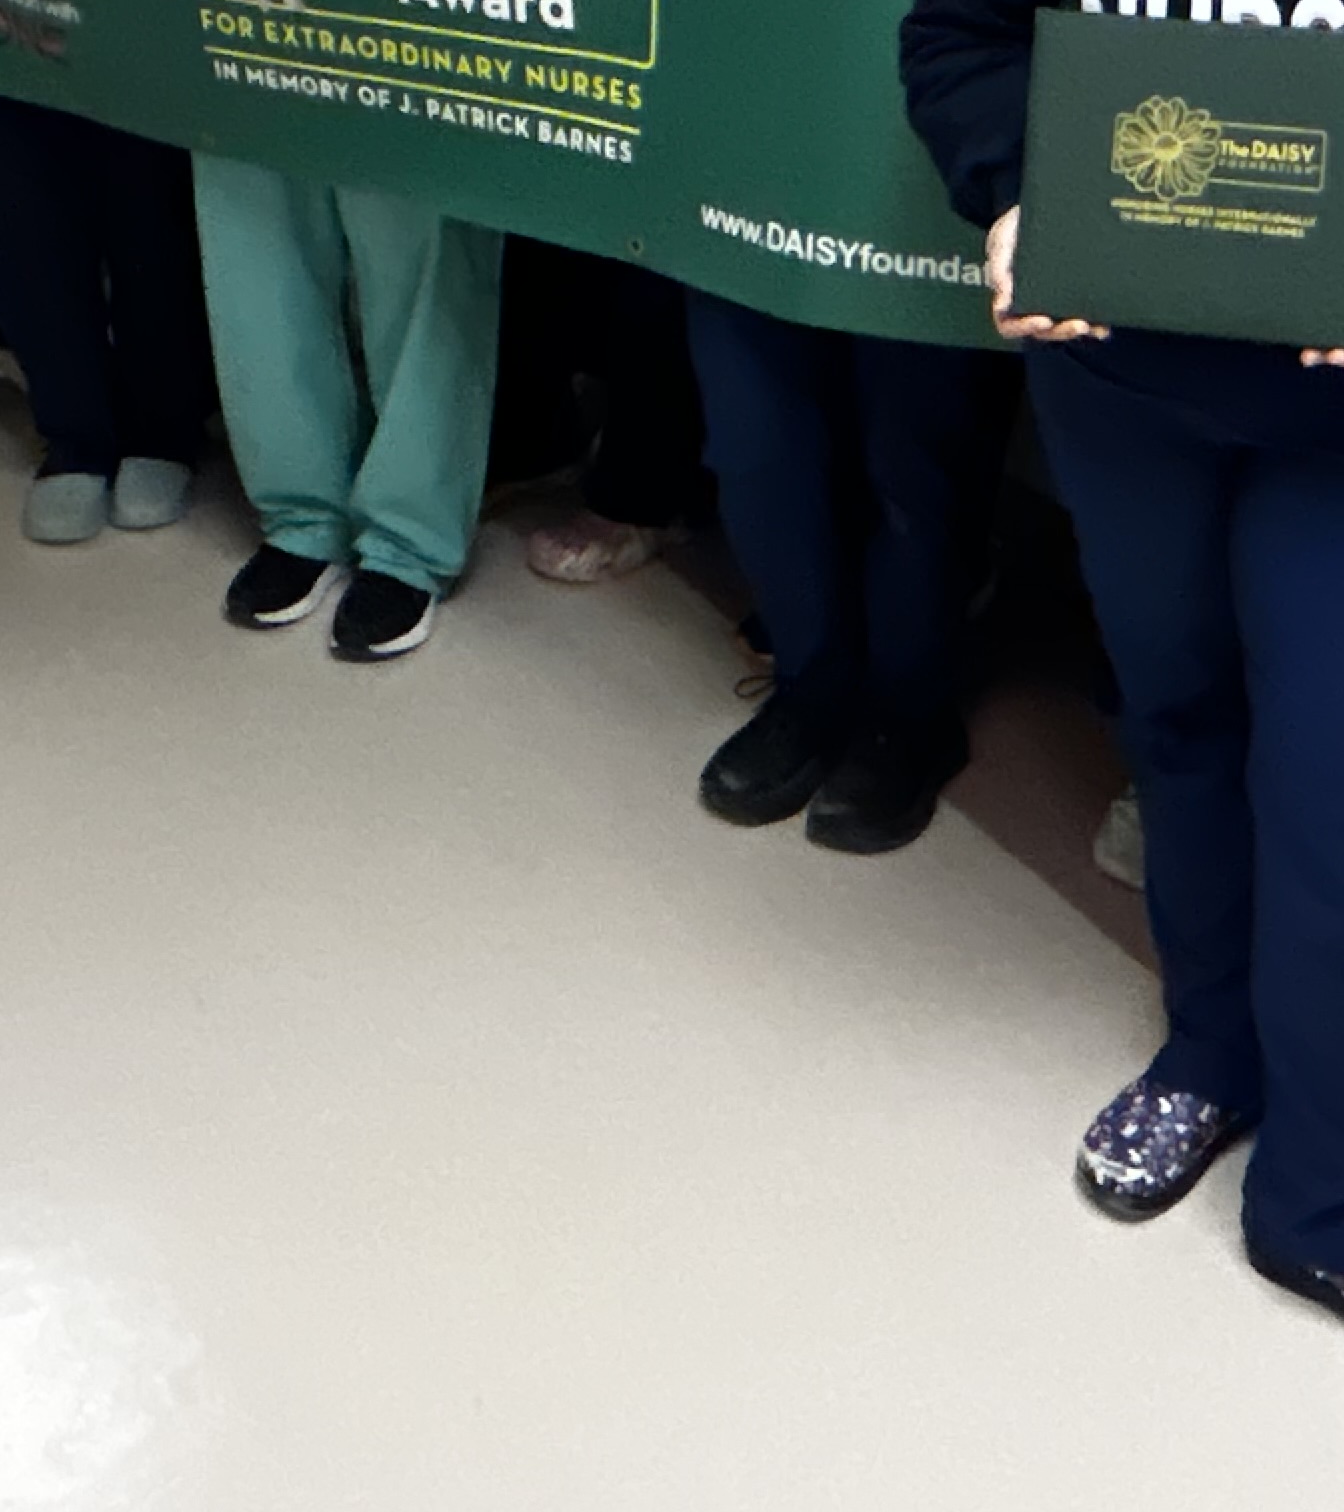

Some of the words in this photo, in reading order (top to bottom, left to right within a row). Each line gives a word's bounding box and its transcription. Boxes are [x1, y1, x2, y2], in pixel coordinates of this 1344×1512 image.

[200, 8, 254, 38] FOR
[262, 19, 512, 83] EXTRAORDINARY
[525, 63, 642, 110] NURSES
[213, 59, 239, 81] IN
[244, 65, 349, 102] MEMORY
[357, 86, 391, 109] OF
[398, 92, 420, 116] J.
[425, 97, 530, 139] PATRICK
[537, 120, 633, 163] BARNES
[1220, 138, 1250, 158] The
[1251, 140, 1316, 163] DAISY
